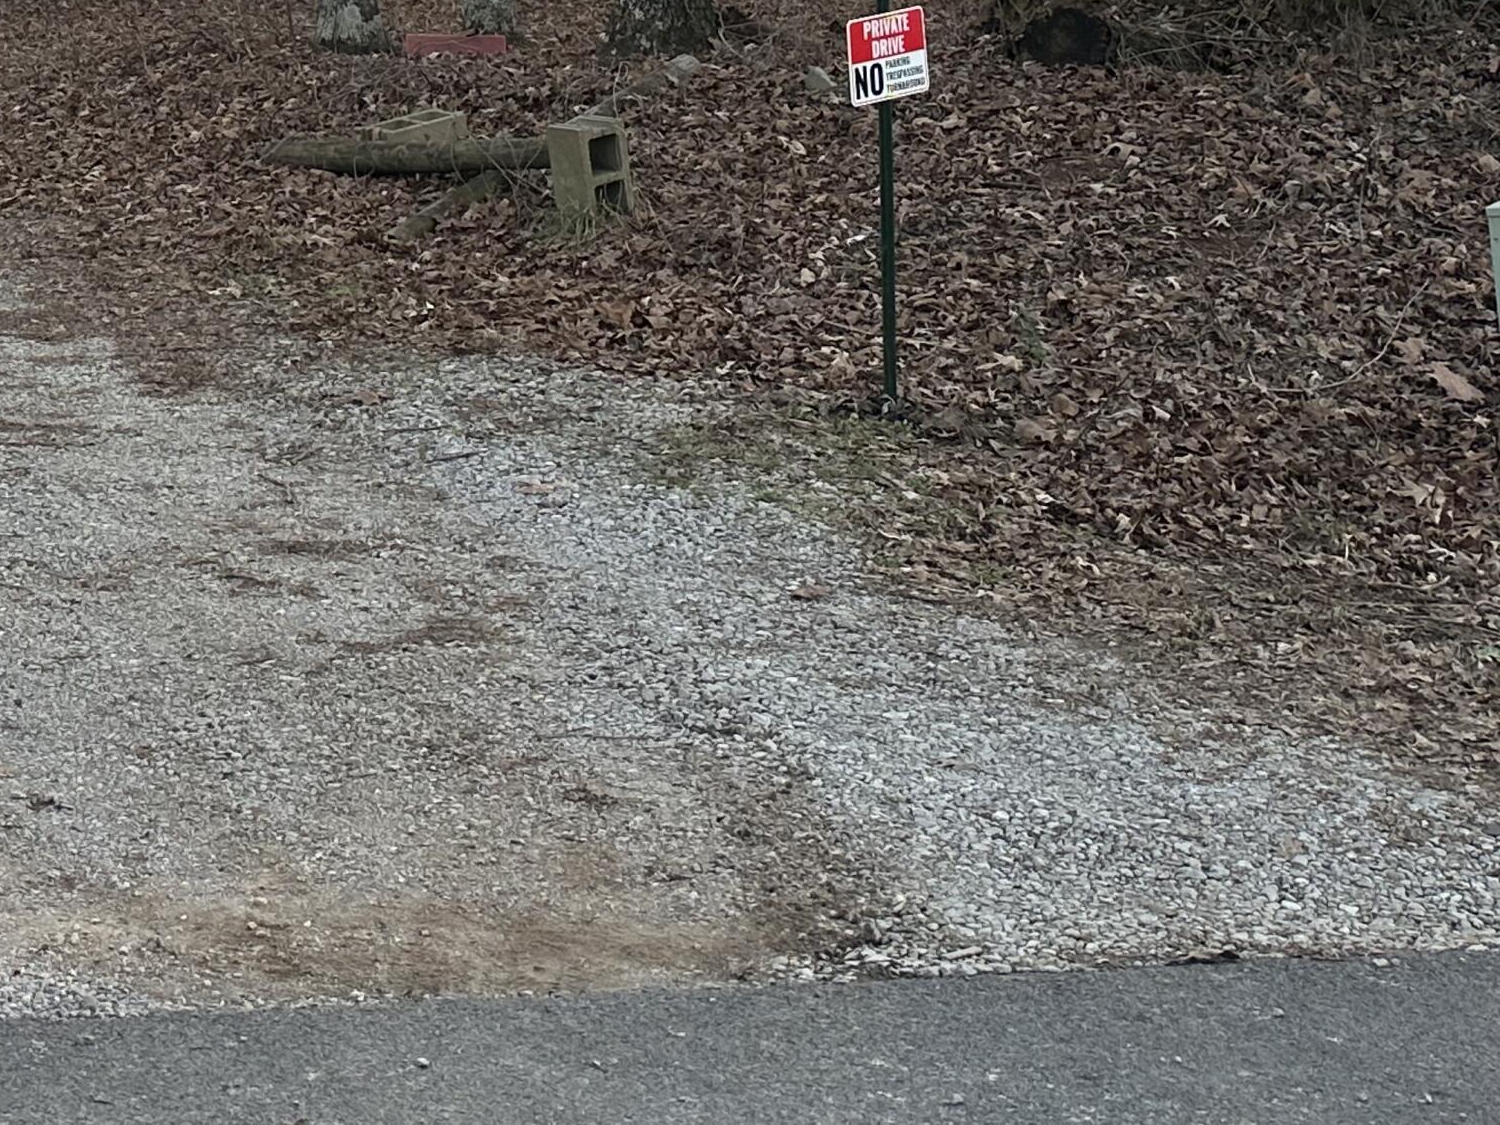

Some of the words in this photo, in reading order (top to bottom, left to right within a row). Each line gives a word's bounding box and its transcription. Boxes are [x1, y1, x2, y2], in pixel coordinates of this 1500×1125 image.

[863, 13, 910, 41] PRIVATE
[871, 35, 906, 59] DRIVE
[885, 56, 911, 69] PARKING
[886, 65, 924, 81] TRESPASSING
[855, 62, 884, 100] NO
